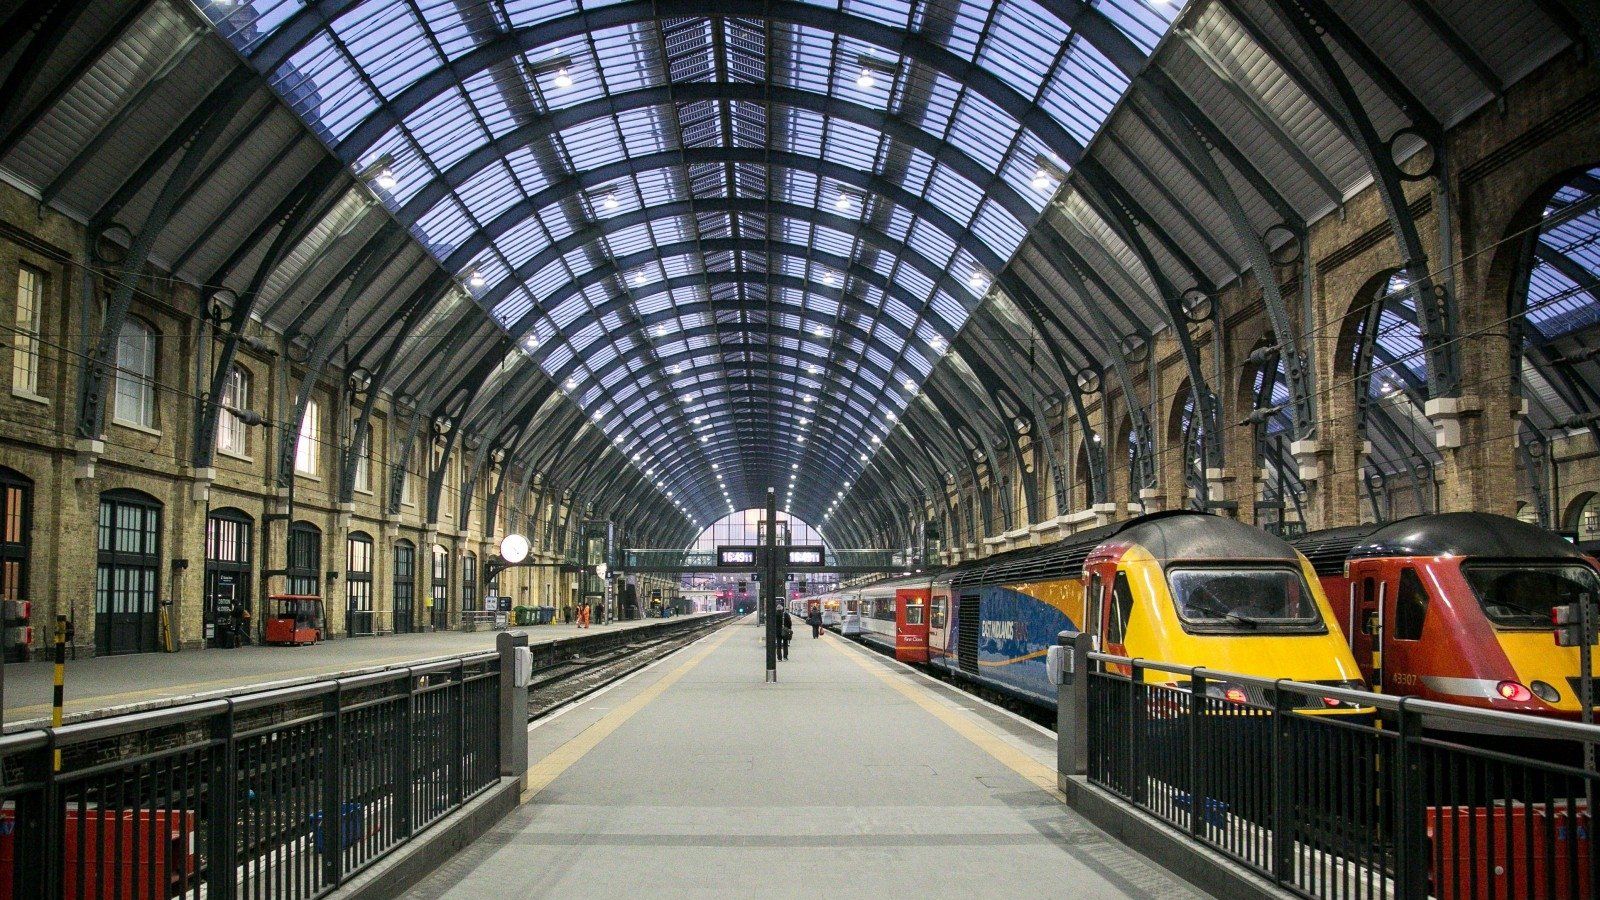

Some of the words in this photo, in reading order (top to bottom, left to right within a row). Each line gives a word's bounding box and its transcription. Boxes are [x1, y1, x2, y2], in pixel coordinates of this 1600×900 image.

[982, 620, 991, 638] EAST
[992, 621, 1014, 640] MIDLANDS
[1394, 673, 1417, 685] 43307
